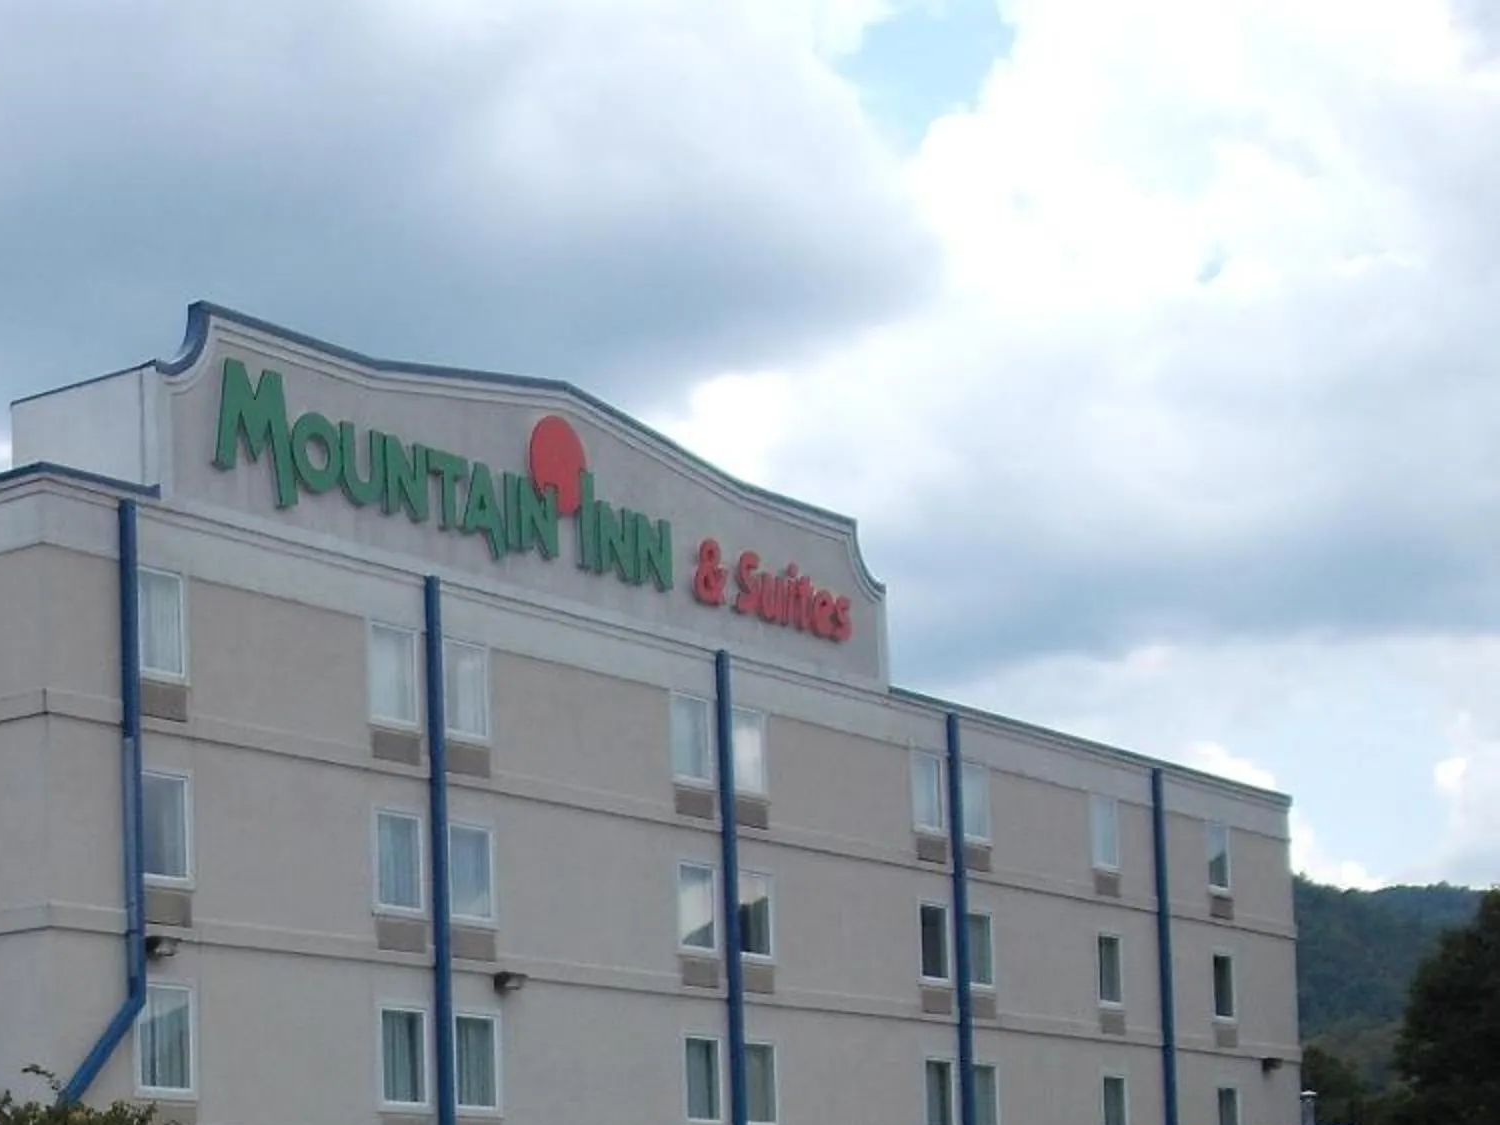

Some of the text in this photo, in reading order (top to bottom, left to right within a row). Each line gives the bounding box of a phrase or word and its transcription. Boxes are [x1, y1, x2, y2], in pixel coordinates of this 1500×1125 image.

[212, 357, 852, 642] MOUNTAIN INN & Suites
